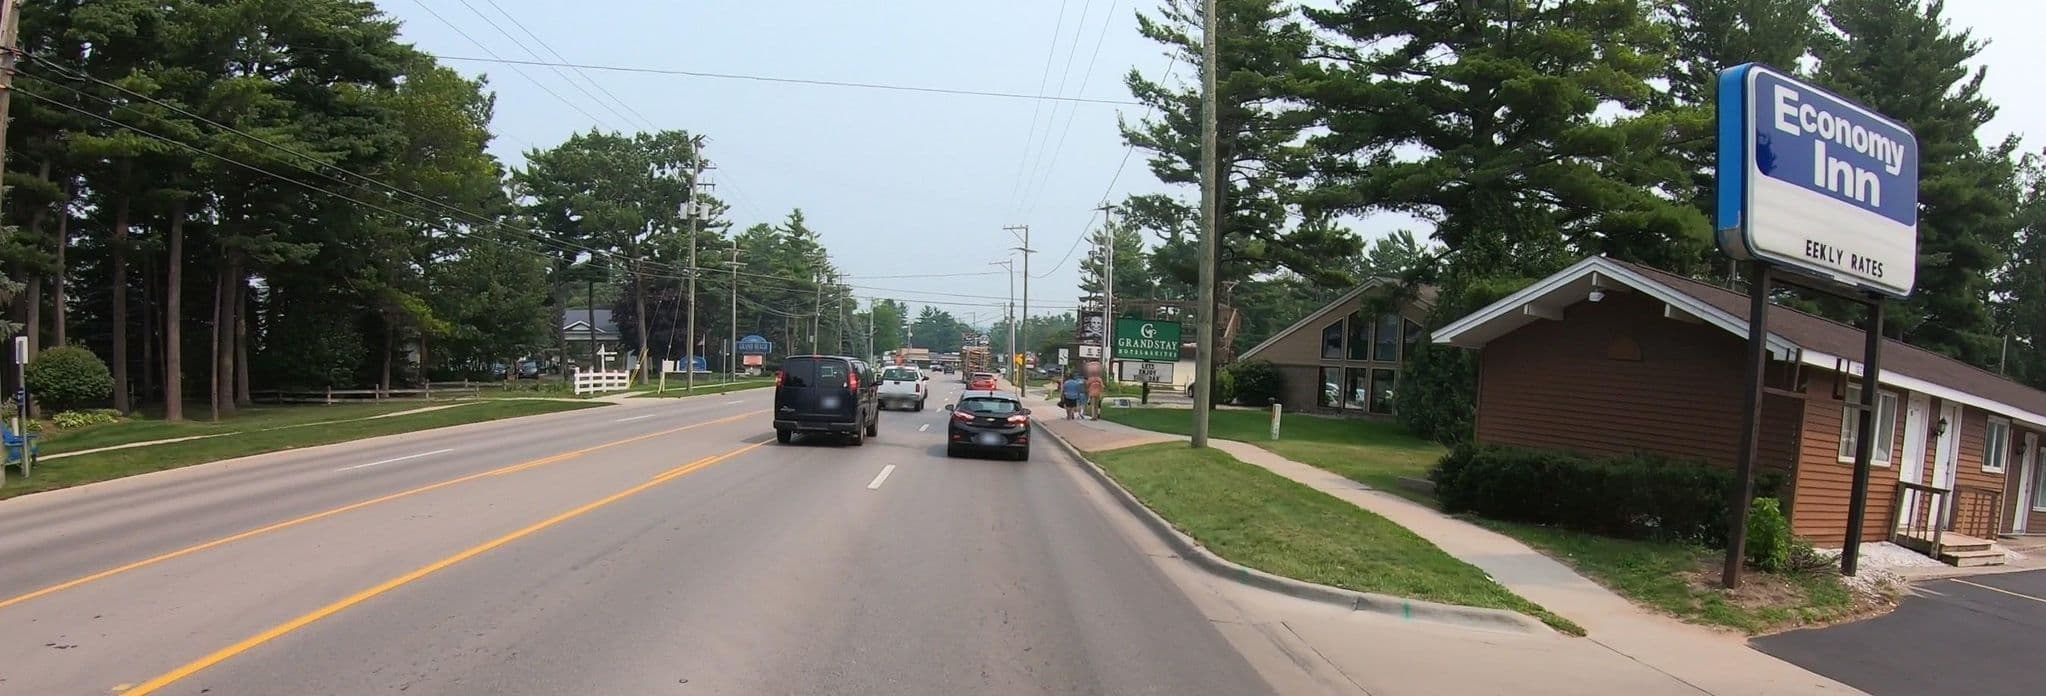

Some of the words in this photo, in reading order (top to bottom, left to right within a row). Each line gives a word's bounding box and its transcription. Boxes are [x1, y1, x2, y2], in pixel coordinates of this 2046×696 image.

[1774, 84, 1904, 176] Economy
[1814, 140, 1881, 208] Inn
[1805, 239, 1844, 266] EEKLY
[1851, 253, 1884, 278] RATES
[1118, 338, 1178, 350] GRANDSTAY
